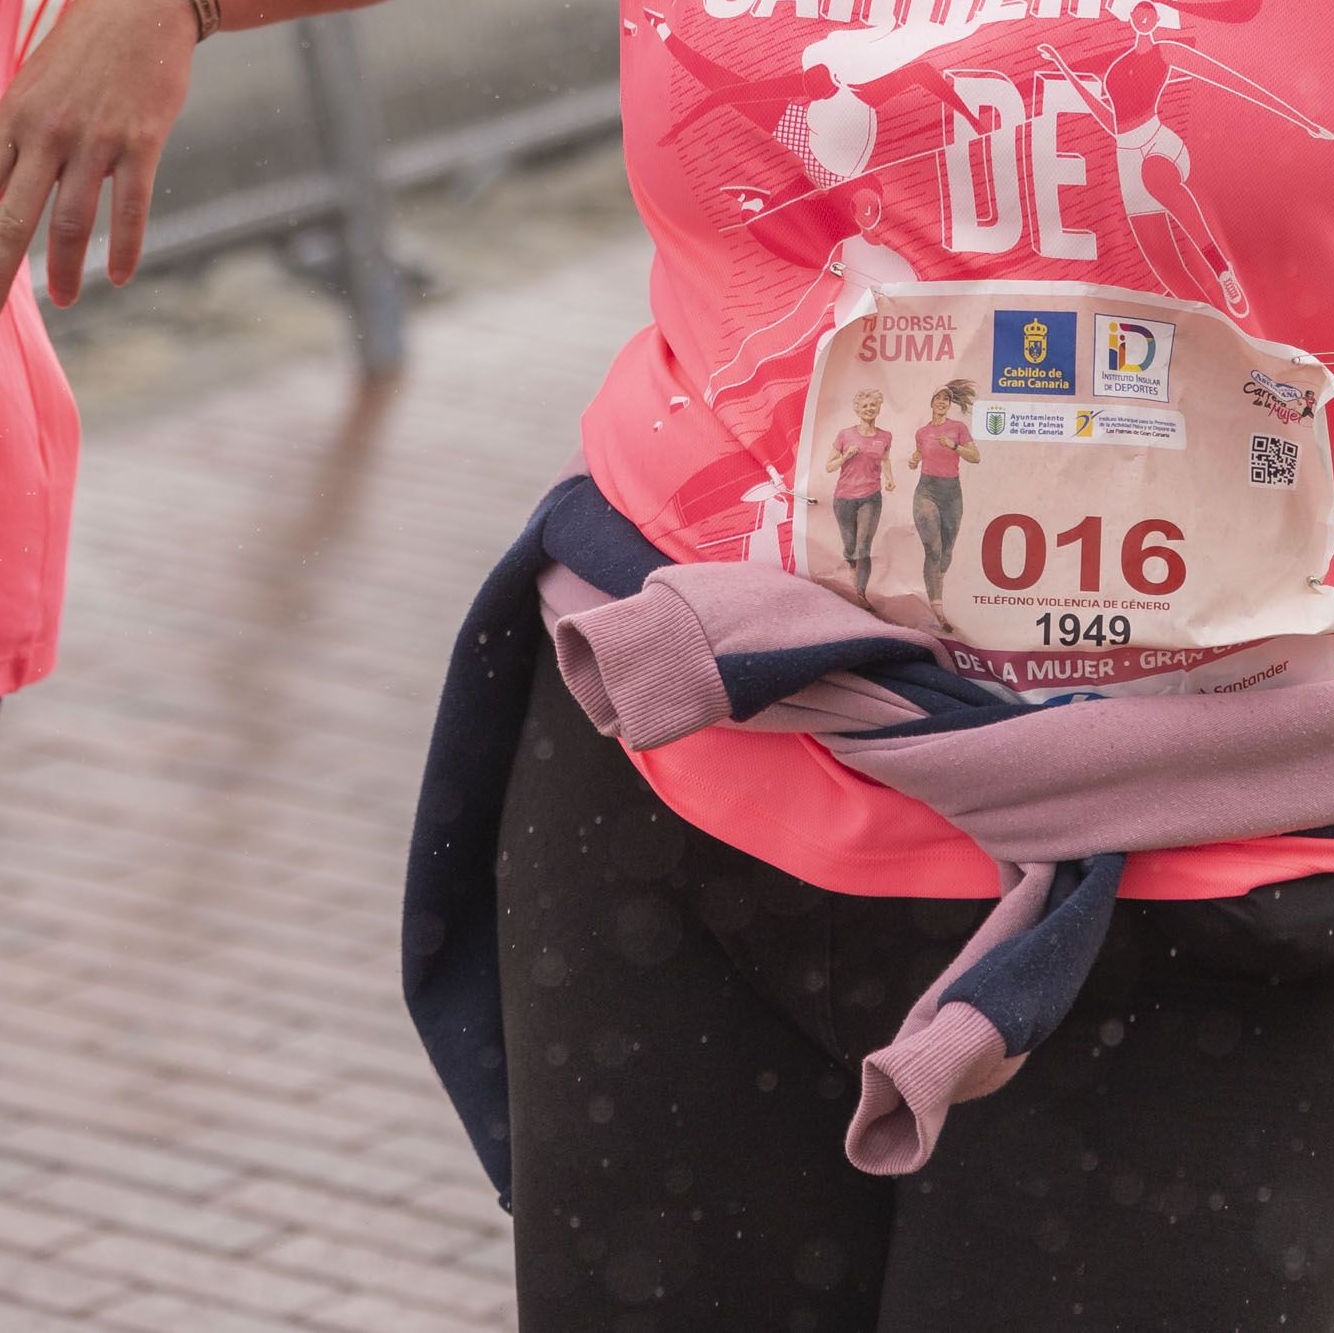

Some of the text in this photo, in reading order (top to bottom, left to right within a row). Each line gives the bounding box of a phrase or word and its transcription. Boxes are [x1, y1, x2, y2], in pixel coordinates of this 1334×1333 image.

[942, 69, 1102, 260] DE
[883, 315, 957, 331] DORSAL
[859, 334, 954, 362] SUMA
[998, 378, 1069, 389] Gran Canaria
[1003, 367, 1062, 378] Cabildo de
[1114, 383, 1158, 395] DEPORTES
[1243, 382, 1286, 407] Carrera
[1010, 414, 1064, 422] Ayuntamiento
[980, 513, 1186, 595] 016
[973, 594, 1170, 611] TELÉFONO VIOLENCIA DE GÉNERO
[1036, 612, 1131, 647] 1949
[955, 650, 1204, 684] DE LA MUJER GRAN
[1214, 660, 1289, 694] Santander
